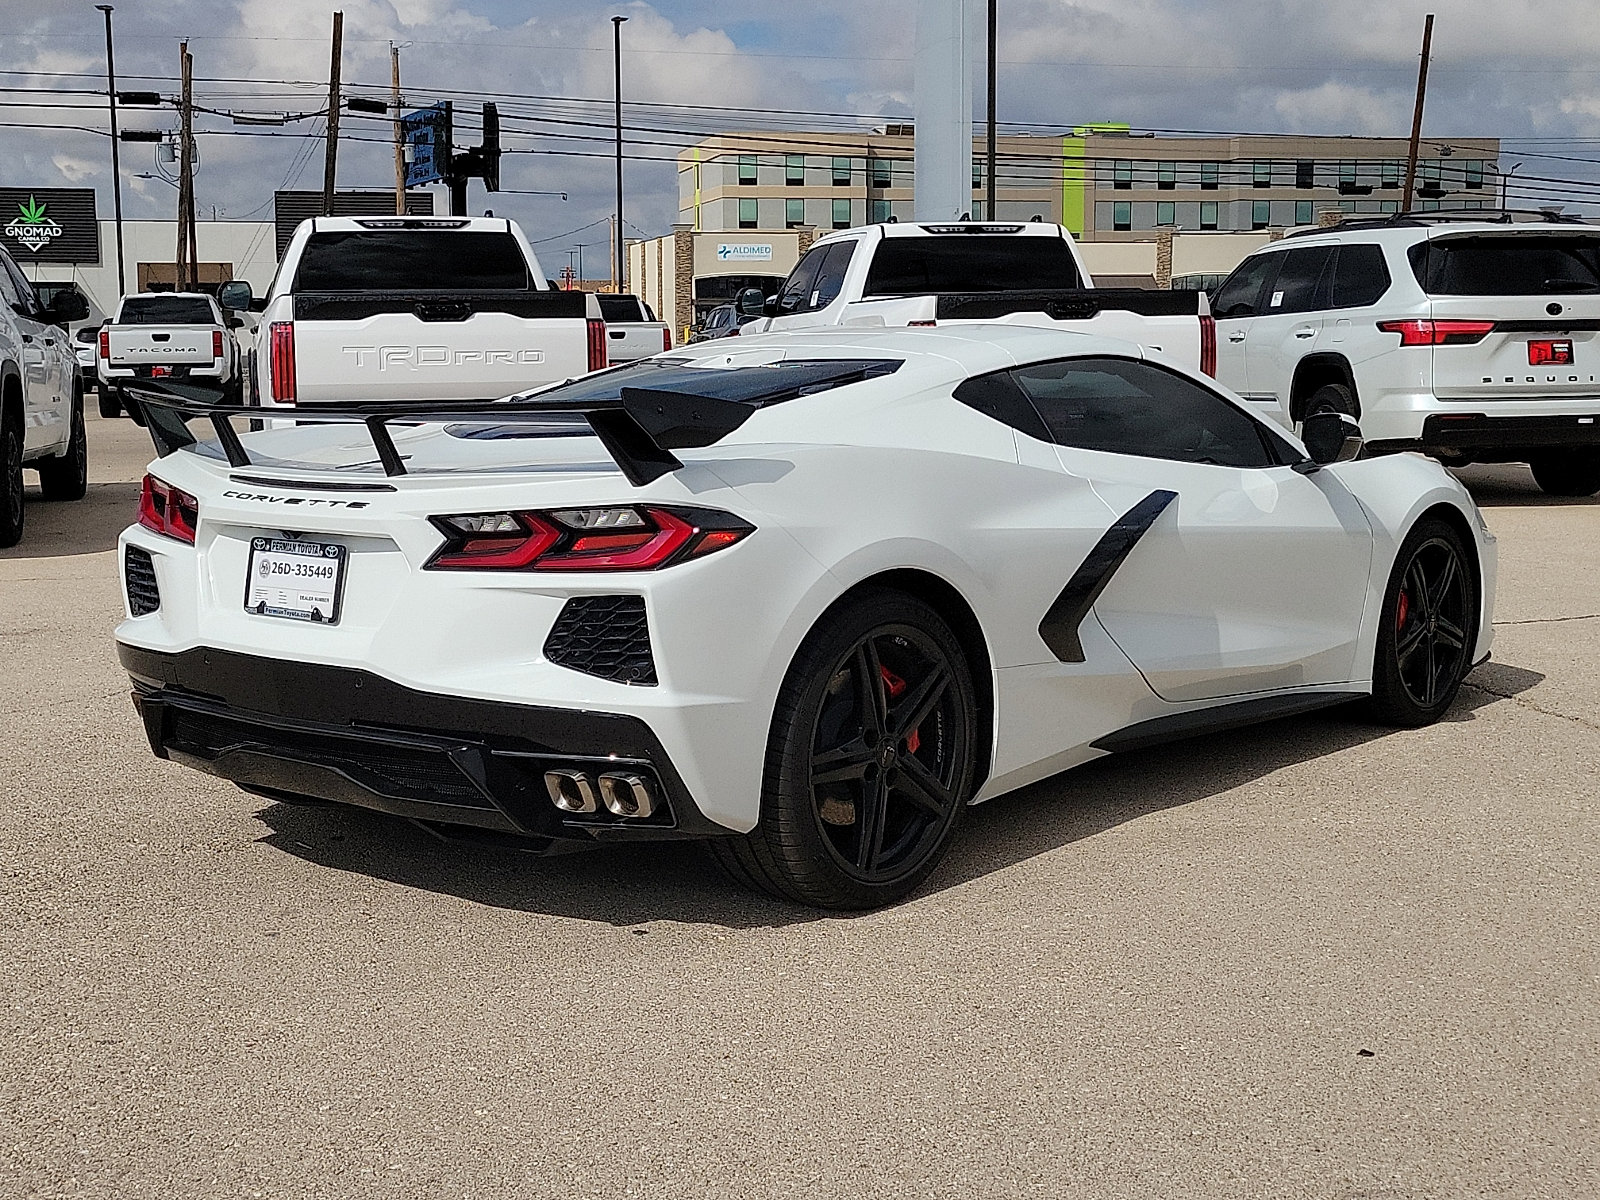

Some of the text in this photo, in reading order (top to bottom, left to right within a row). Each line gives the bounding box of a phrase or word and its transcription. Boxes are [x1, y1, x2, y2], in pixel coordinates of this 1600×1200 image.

[5, 227, 62, 237] GNOMAD
[733, 246, 771, 254] ALDIMED
[1482, 375, 1594, 383] SEQUOI
[222, 490, 371, 509] CORVETTE
[272, 541, 320, 555] PERMIAN TOYOTA
[271, 561, 333, 579] 26D-335449
[265, 607, 311, 619] PermianToyota.com
